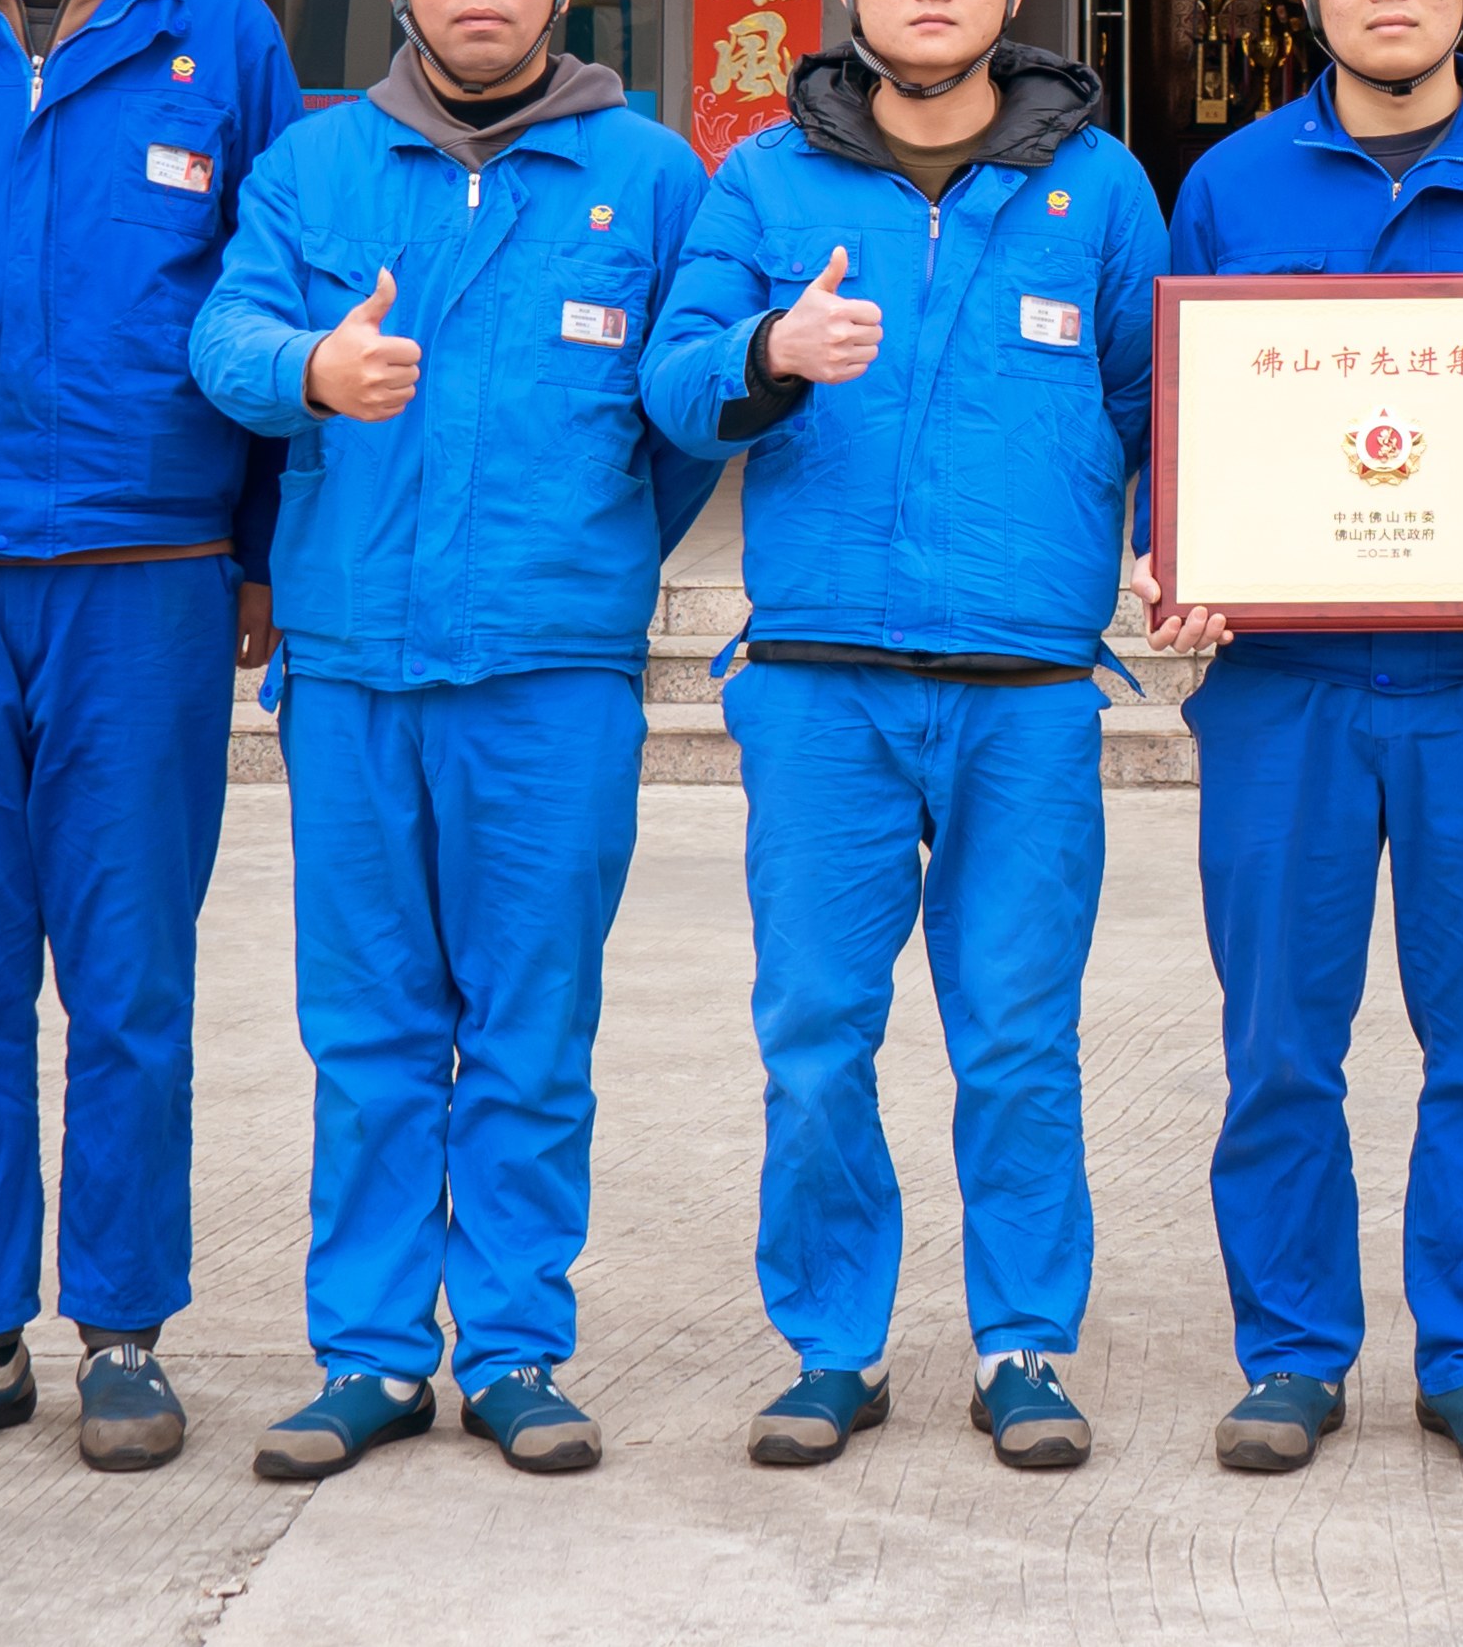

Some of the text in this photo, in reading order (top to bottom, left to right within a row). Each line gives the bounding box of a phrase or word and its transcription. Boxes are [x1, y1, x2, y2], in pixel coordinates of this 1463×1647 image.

[1332, 510, 1436, 524] 中共佛山市委
[1333, 528, 1435, 542] 佛山市人民政府
